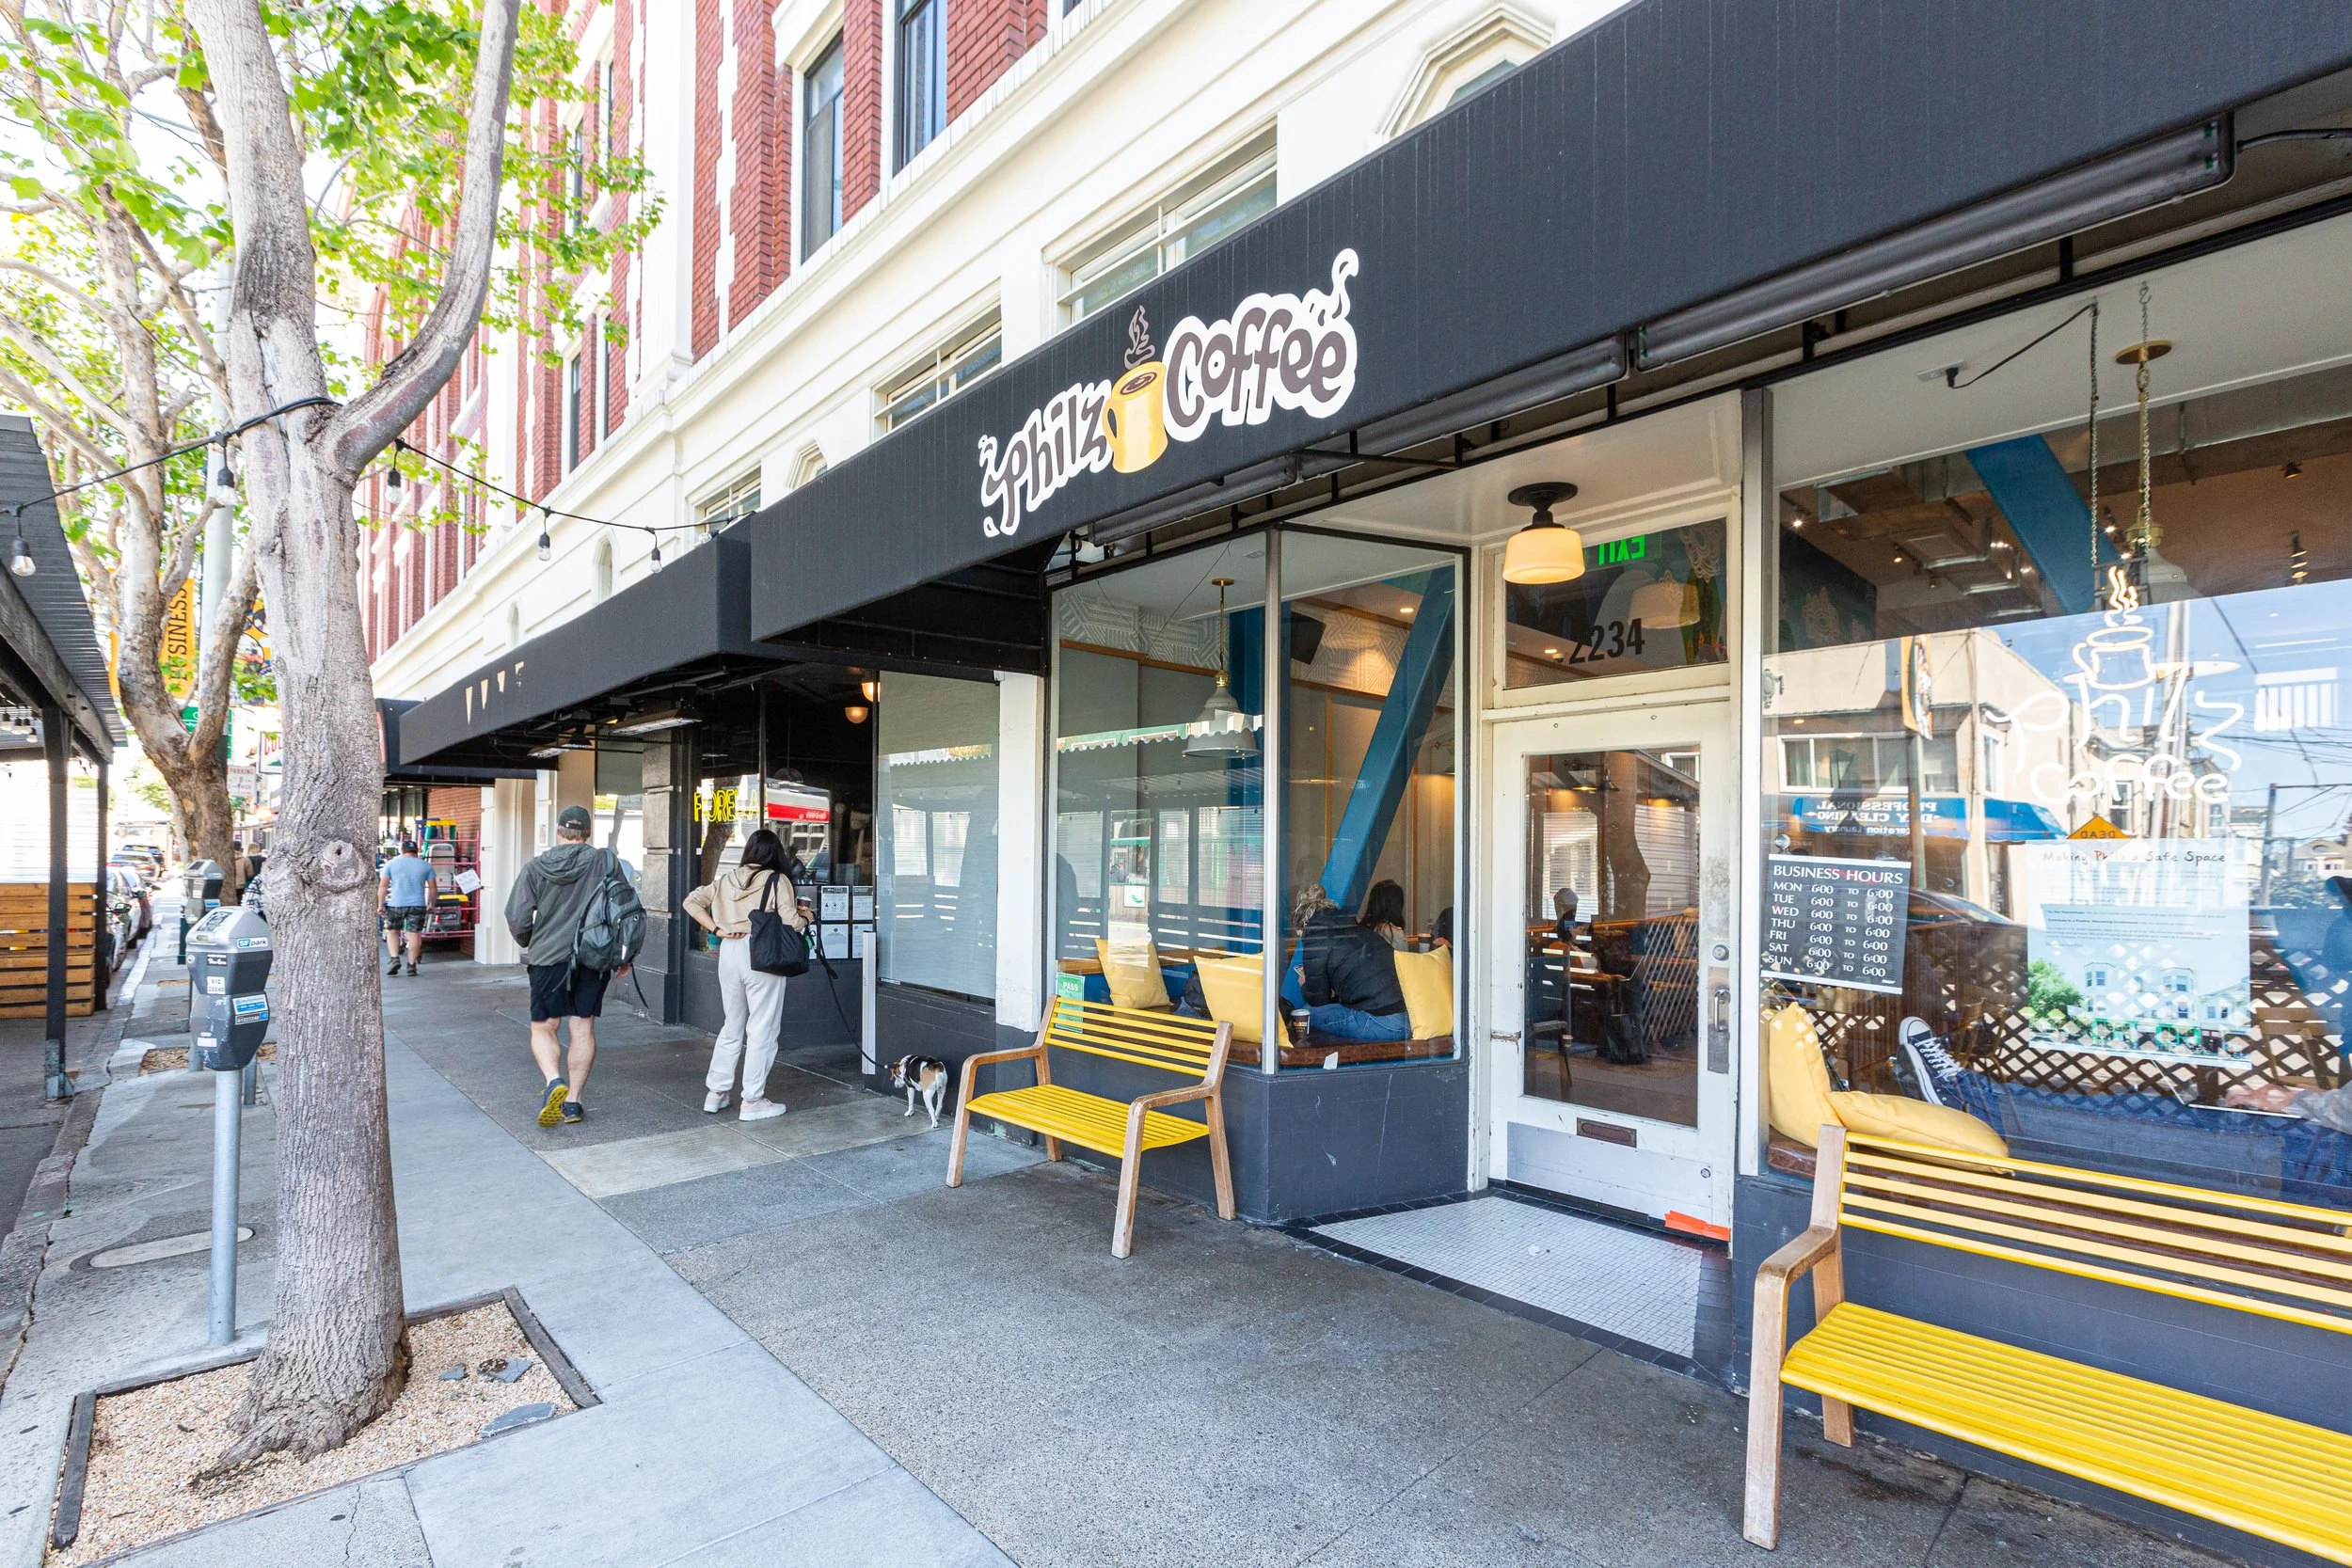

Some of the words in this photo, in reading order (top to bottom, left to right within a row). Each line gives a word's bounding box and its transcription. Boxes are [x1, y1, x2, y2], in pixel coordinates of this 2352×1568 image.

[1165, 292, 1355, 438] Coffee
[1568, 618, 1645, 665] 2234
[693, 788, 761, 822] FOREA
[2184, 851, 2226, 866] Space
[1773, 864, 1840, 880] BUSINESS
[1846, 869, 1904, 884] HOURS
[1773, 881, 1803, 892] MON
[1811, 884, 1834, 895] 6:00
[1867, 889, 1894, 899] 6:00
[1772, 893, 1794, 904] TUE
[1811, 896, 1834, 907] 6:00
[1867, 901, 1894, 912] 6:00
[1772, 905, 1799, 916] WED
[1811, 910, 1834, 919] 6:00
[1867, 914, 1893, 926] 6:00
[1771, 918, 1796, 928] THU
[1809, 922, 1833, 932] 6:00
[1865, 927, 1890, 938] 6:00
[1770, 930, 1787, 941] FRI
[1809, 934, 1833, 945] 6:00
[1863, 940, 1888, 951] 6:00
[1769, 942, 1789, 953] SAT
[1808, 947, 1832, 958] 6:00
[1863, 953, 1887, 964] 6:00
[1768, 954, 1792, 965] SUN
[1806, 960, 1830, 971] 6:00
[1862, 966, 1885, 977] 6:00
[1063, 981, 1079, 991] PASS
